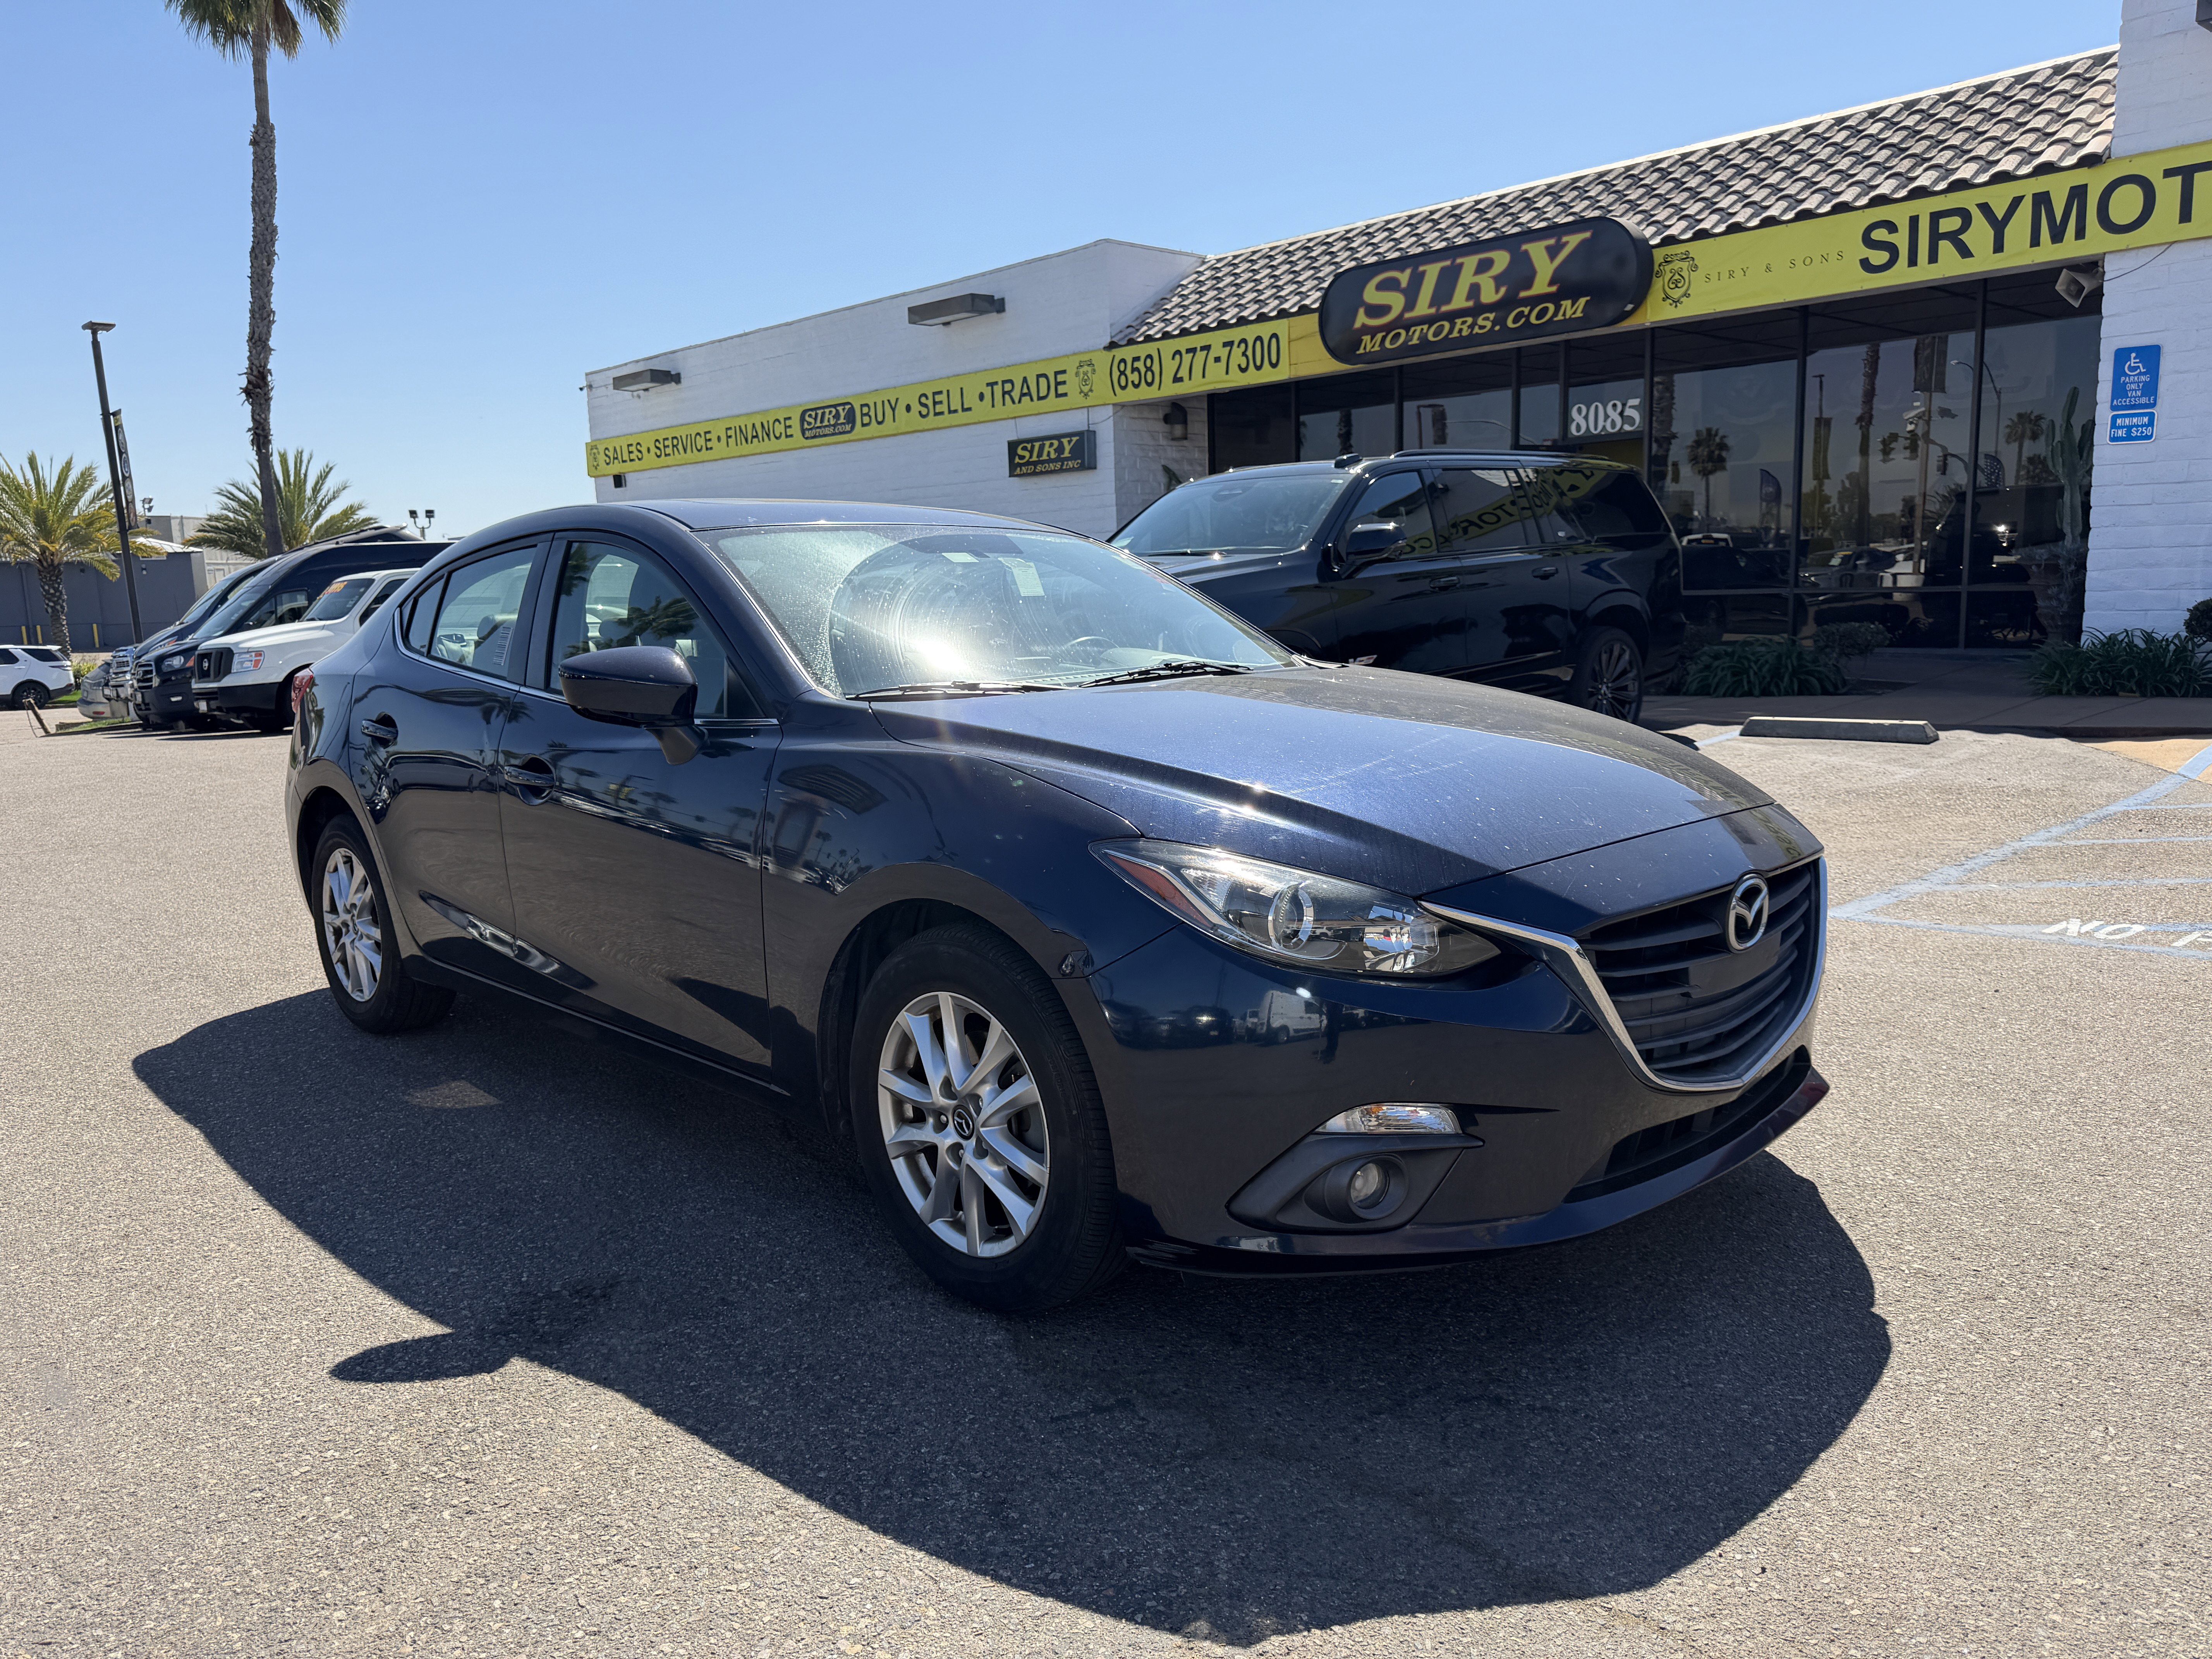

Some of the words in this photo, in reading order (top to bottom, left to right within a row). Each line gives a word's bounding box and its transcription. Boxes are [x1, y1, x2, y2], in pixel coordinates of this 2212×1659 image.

[1859, 161, 2212, 274] SIRYMOT
[1353, 230, 1592, 330] SIRY
[1704, 266, 1749, 283] SIRY
[1764, 263, 1773, 273] &
[1789, 251, 1844, 269] SONS
[1357, 297, 1590, 354] MOTORS.COM
[1110, 348, 1163, 397] (858)
[1171, 333, 1280, 384] 277-7300
[2121, 375, 2150, 383] PARKING
[860, 397, 900, 428] BUY
[918, 387, 972, 419] SELL
[986, 369, 1068, 408] TRADE
[2113, 396, 2155, 405] ACCESSIBLE
[802, 404, 852, 429] SIRY
[1570, 398, 1641, 436] 8085
[2116, 417, 2148, 426] MINIMUM
[604, 442, 644, 466] SALES
[654, 431, 713, 458] SERVICE
[726, 416, 793, 448] FINANCE
[804, 424, 852, 438] MOTORS.COM
[2111, 428, 2127, 437] FINE
[2131, 427, 2152, 437] $250
[1014, 436, 1080, 464] SIRY
[1014, 465, 1034, 475] AND
[1036, 462, 1061, 472] SONS
[1063, 460, 1081, 469] INC
[2042, 919, 2145, 939] NO
